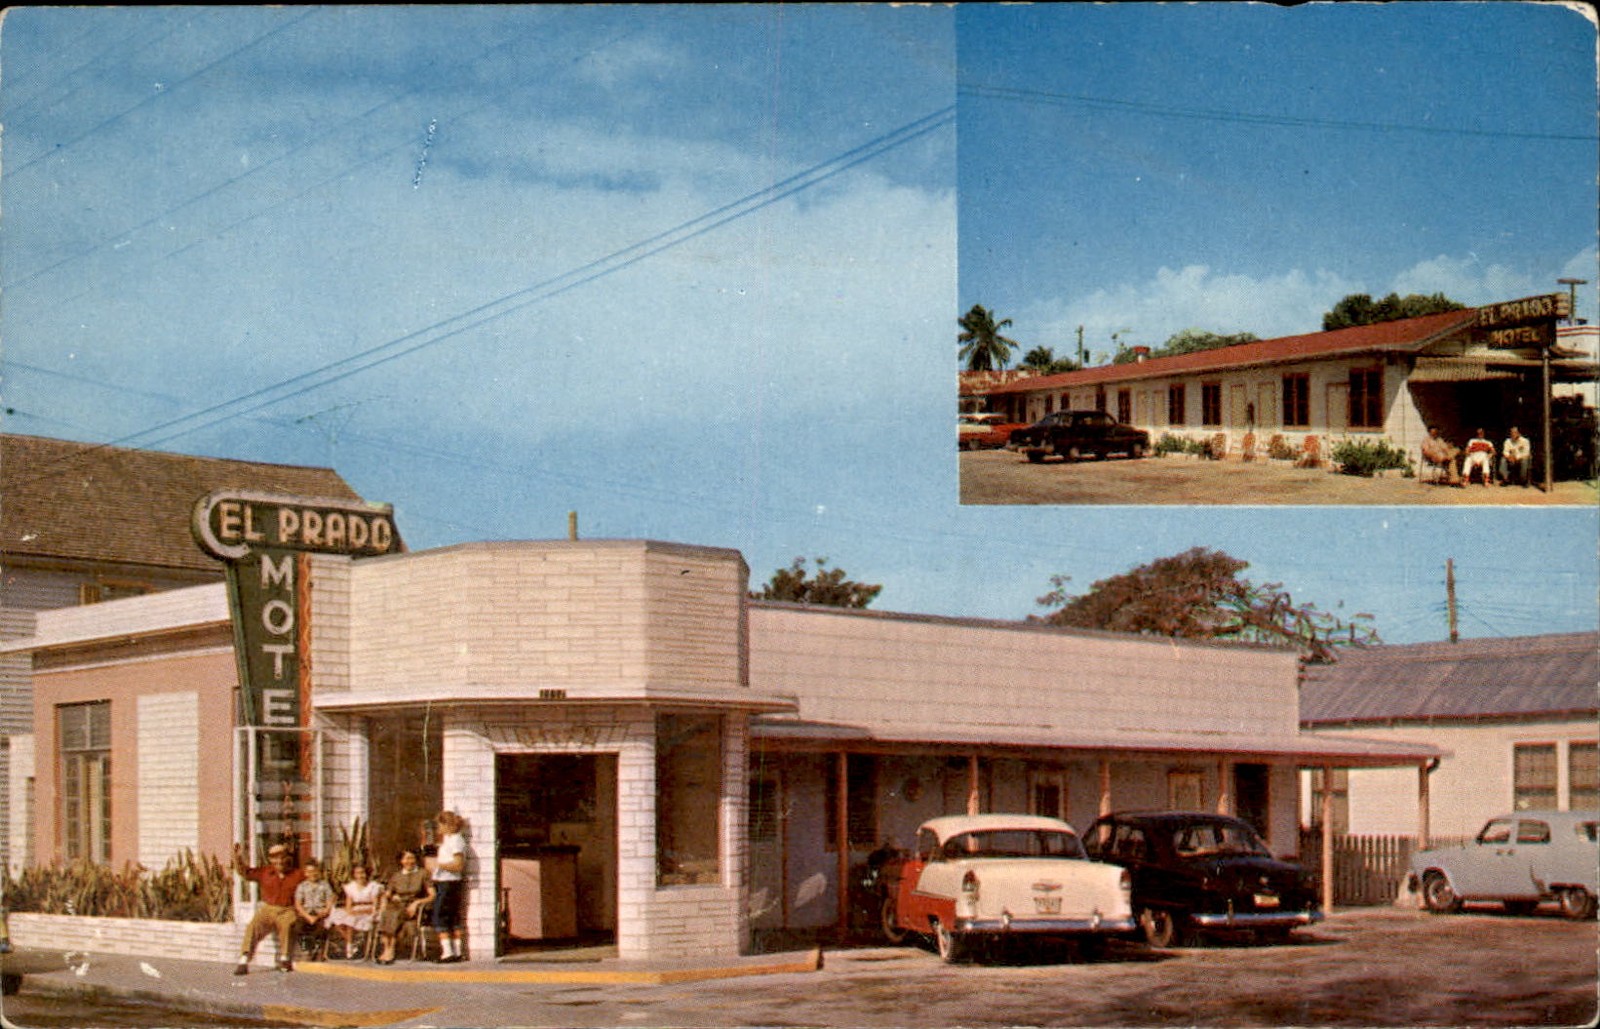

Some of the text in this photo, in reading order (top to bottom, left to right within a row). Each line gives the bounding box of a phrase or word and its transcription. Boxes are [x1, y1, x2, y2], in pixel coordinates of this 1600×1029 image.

[1490, 326, 1541, 345] MOTEL
[218, 502, 392, 550] EL PRADO
[261, 554, 296, 768] MOTEL
